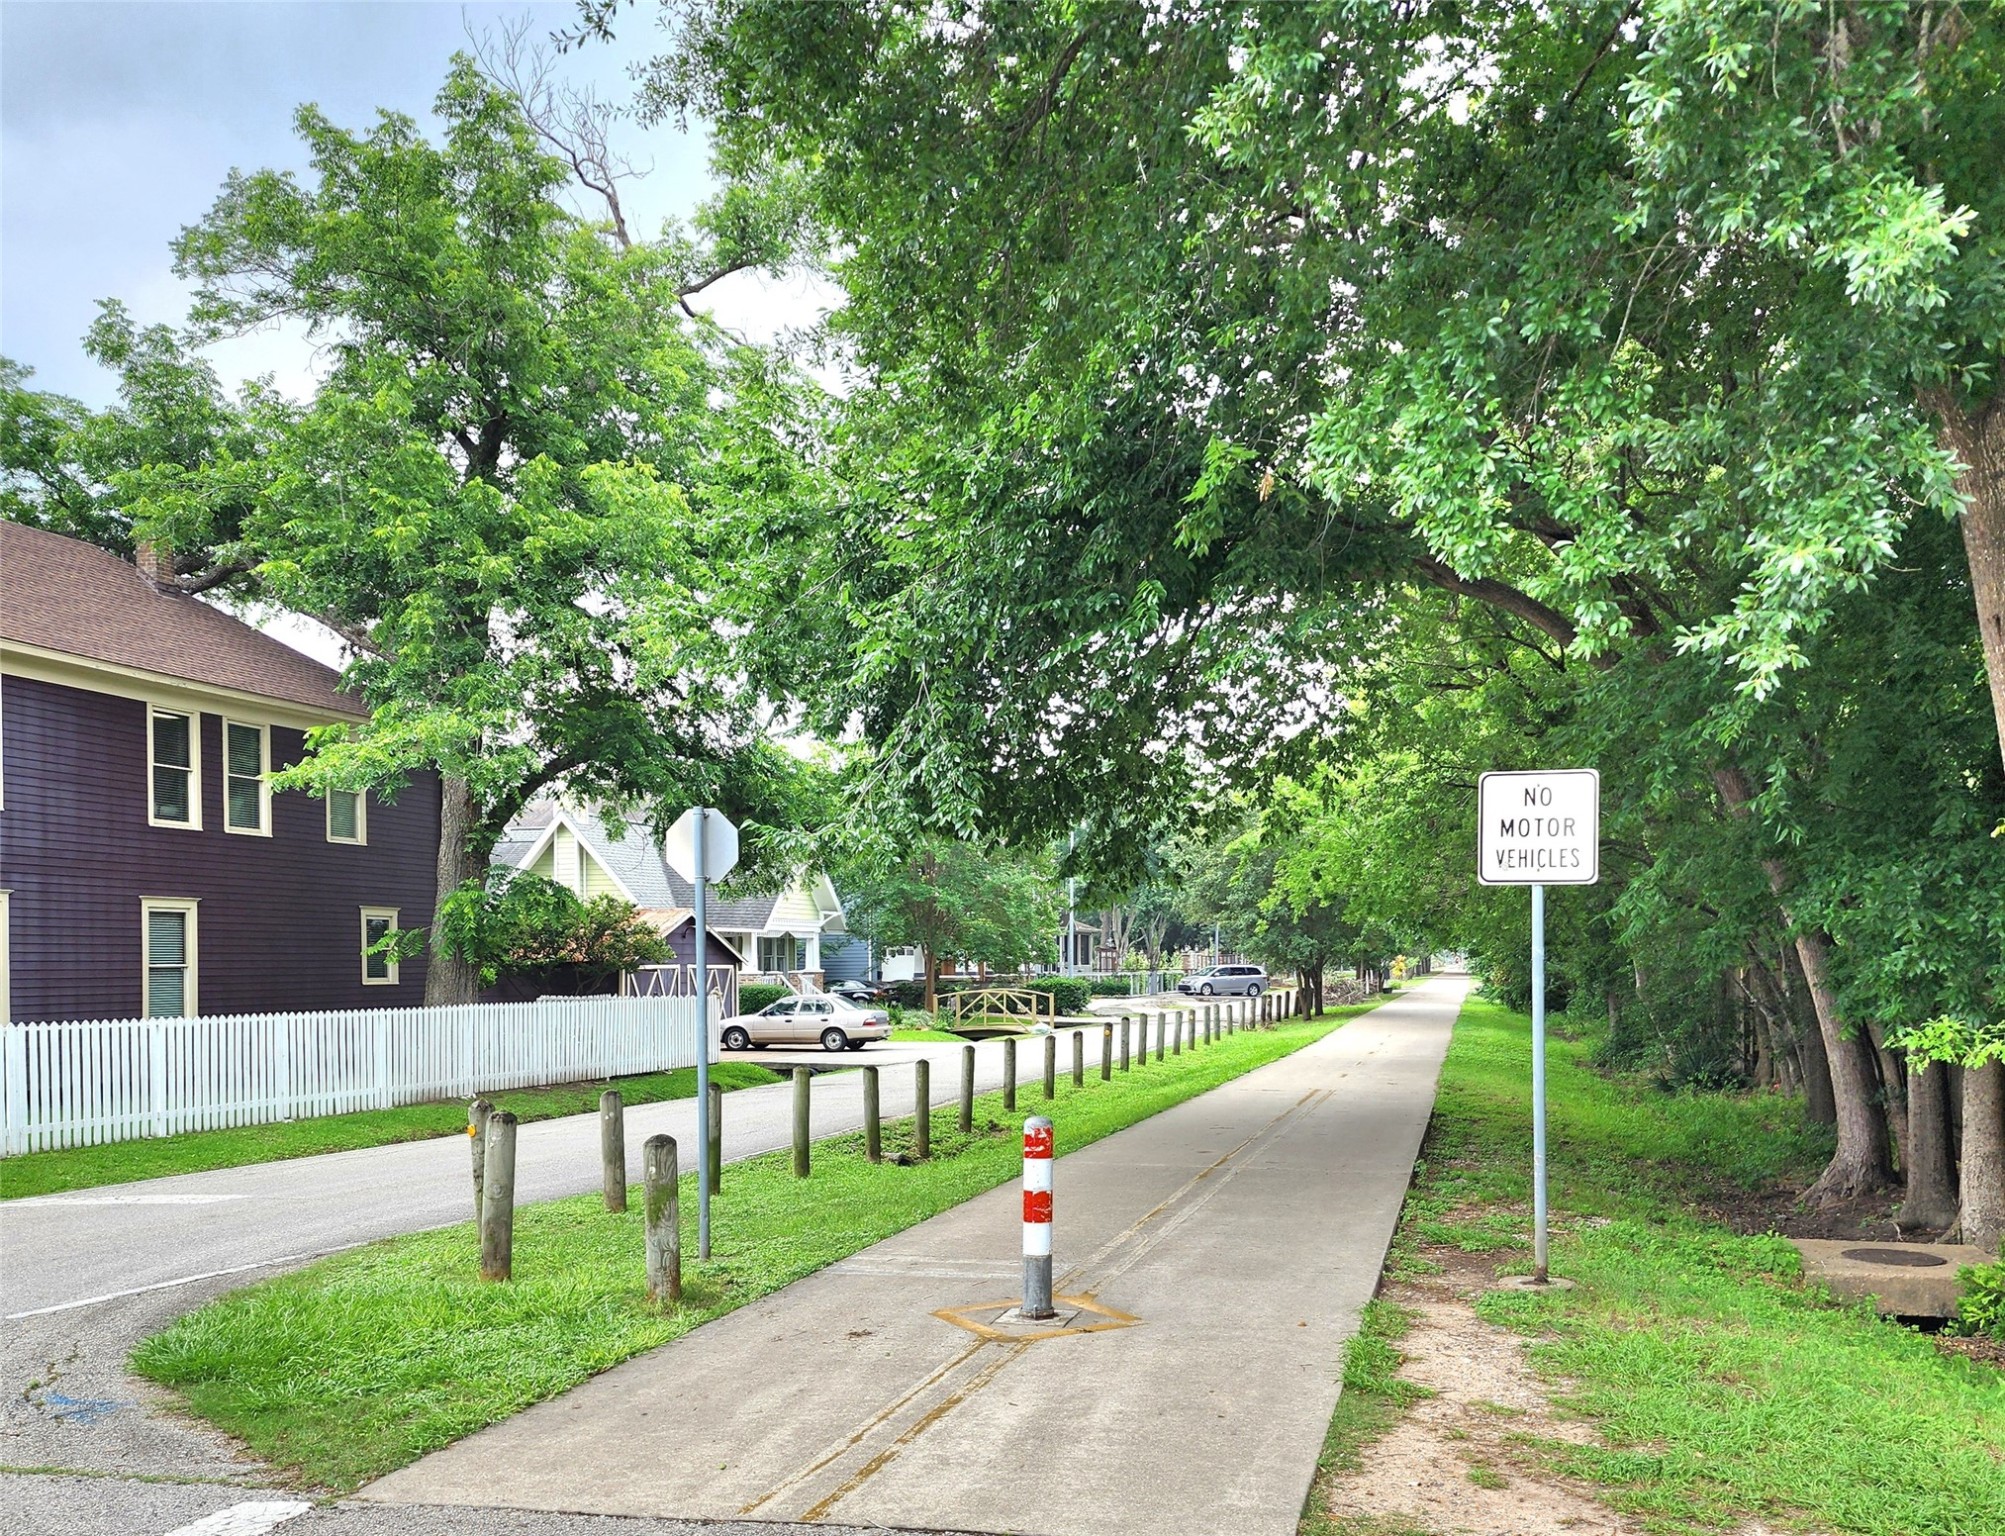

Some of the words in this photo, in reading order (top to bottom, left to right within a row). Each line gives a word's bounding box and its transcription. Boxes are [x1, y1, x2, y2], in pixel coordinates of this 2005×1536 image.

[1525, 787, 1552, 806] NO
[1500, 817, 1575, 837] MOTOR
[1496, 848, 1580, 868] VEHICLES
